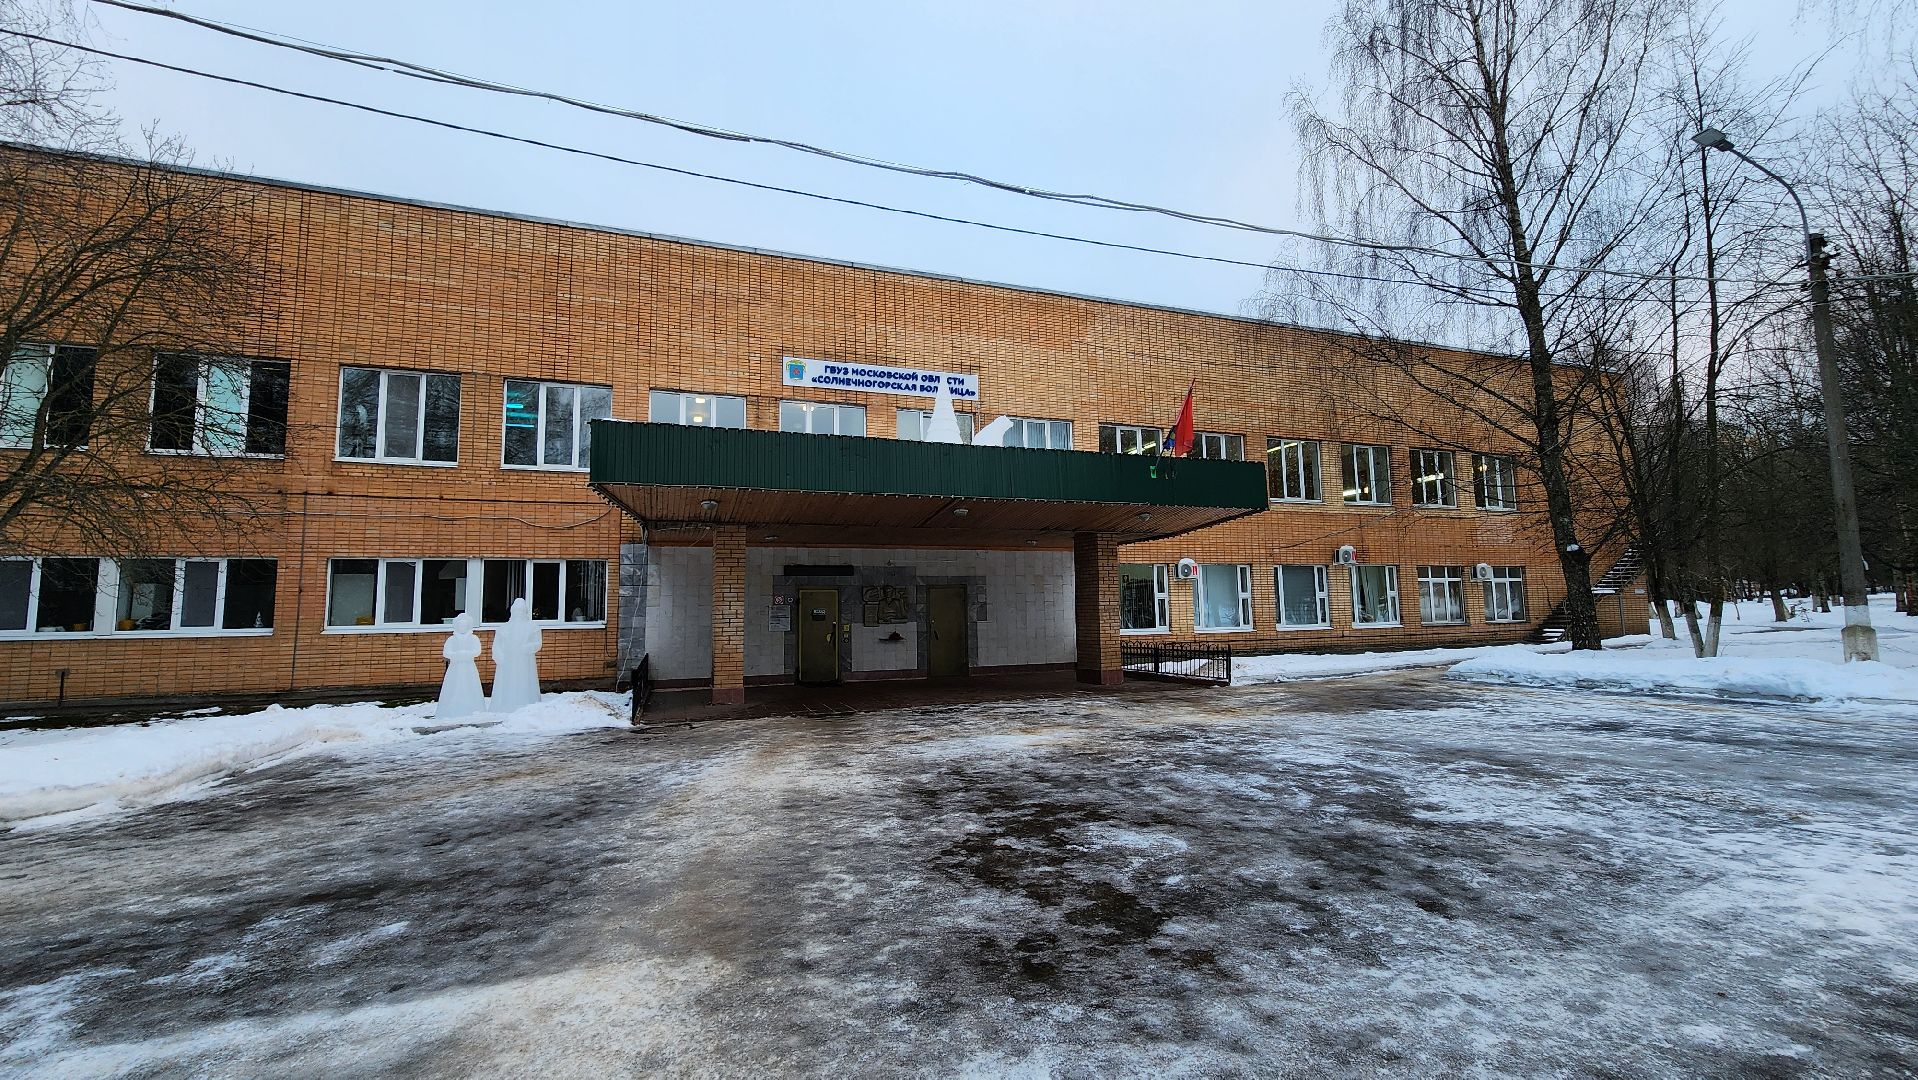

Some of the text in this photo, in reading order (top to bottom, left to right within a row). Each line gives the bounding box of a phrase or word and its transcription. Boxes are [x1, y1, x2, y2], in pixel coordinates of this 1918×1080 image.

[811, 375, 977, 397] «СОЛНЕЧНОГОРСКАЯ БОЛИЦА»
[825, 366, 965, 386] ГБУЗ МОСКОВСКОЙ ОБЛСТИ
